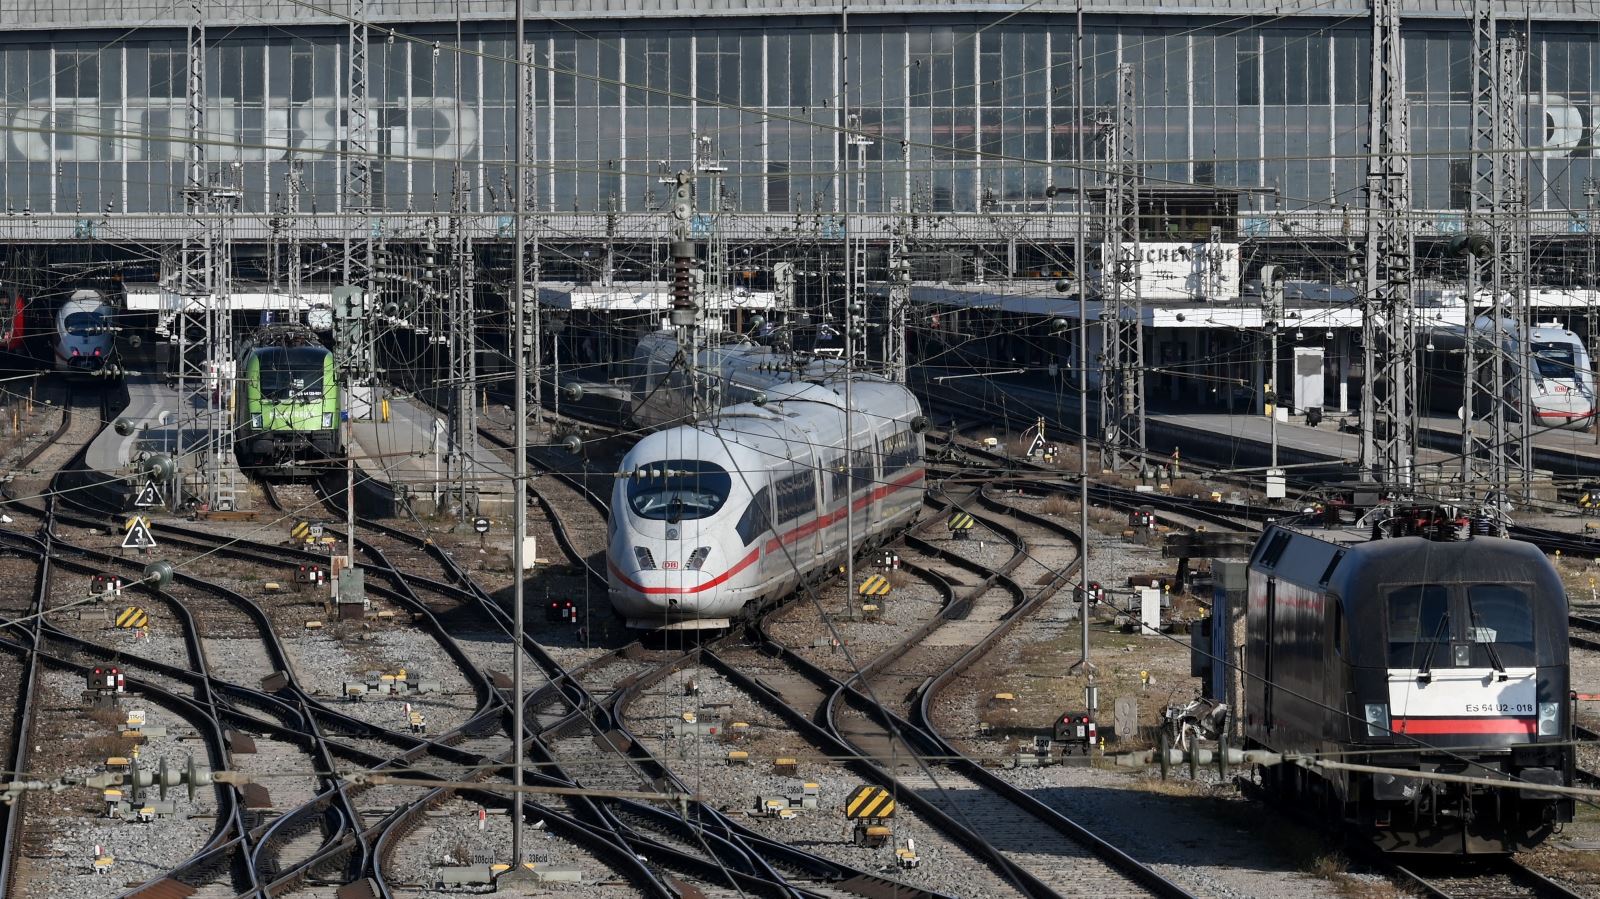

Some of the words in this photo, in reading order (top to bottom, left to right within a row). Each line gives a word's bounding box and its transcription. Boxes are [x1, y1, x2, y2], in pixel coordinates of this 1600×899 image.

[146, 487, 154, 503] 3
[134, 526, 143, 543] 3
[663, 561, 678, 569] DB
[1466, 704, 1479, 712] ES
[1482, 704, 1493, 712] 64
[1496, 704, 1509, 712] U2
[1517, 704, 1533, 712] 018
[1036, 739, 1050, 748] 320
